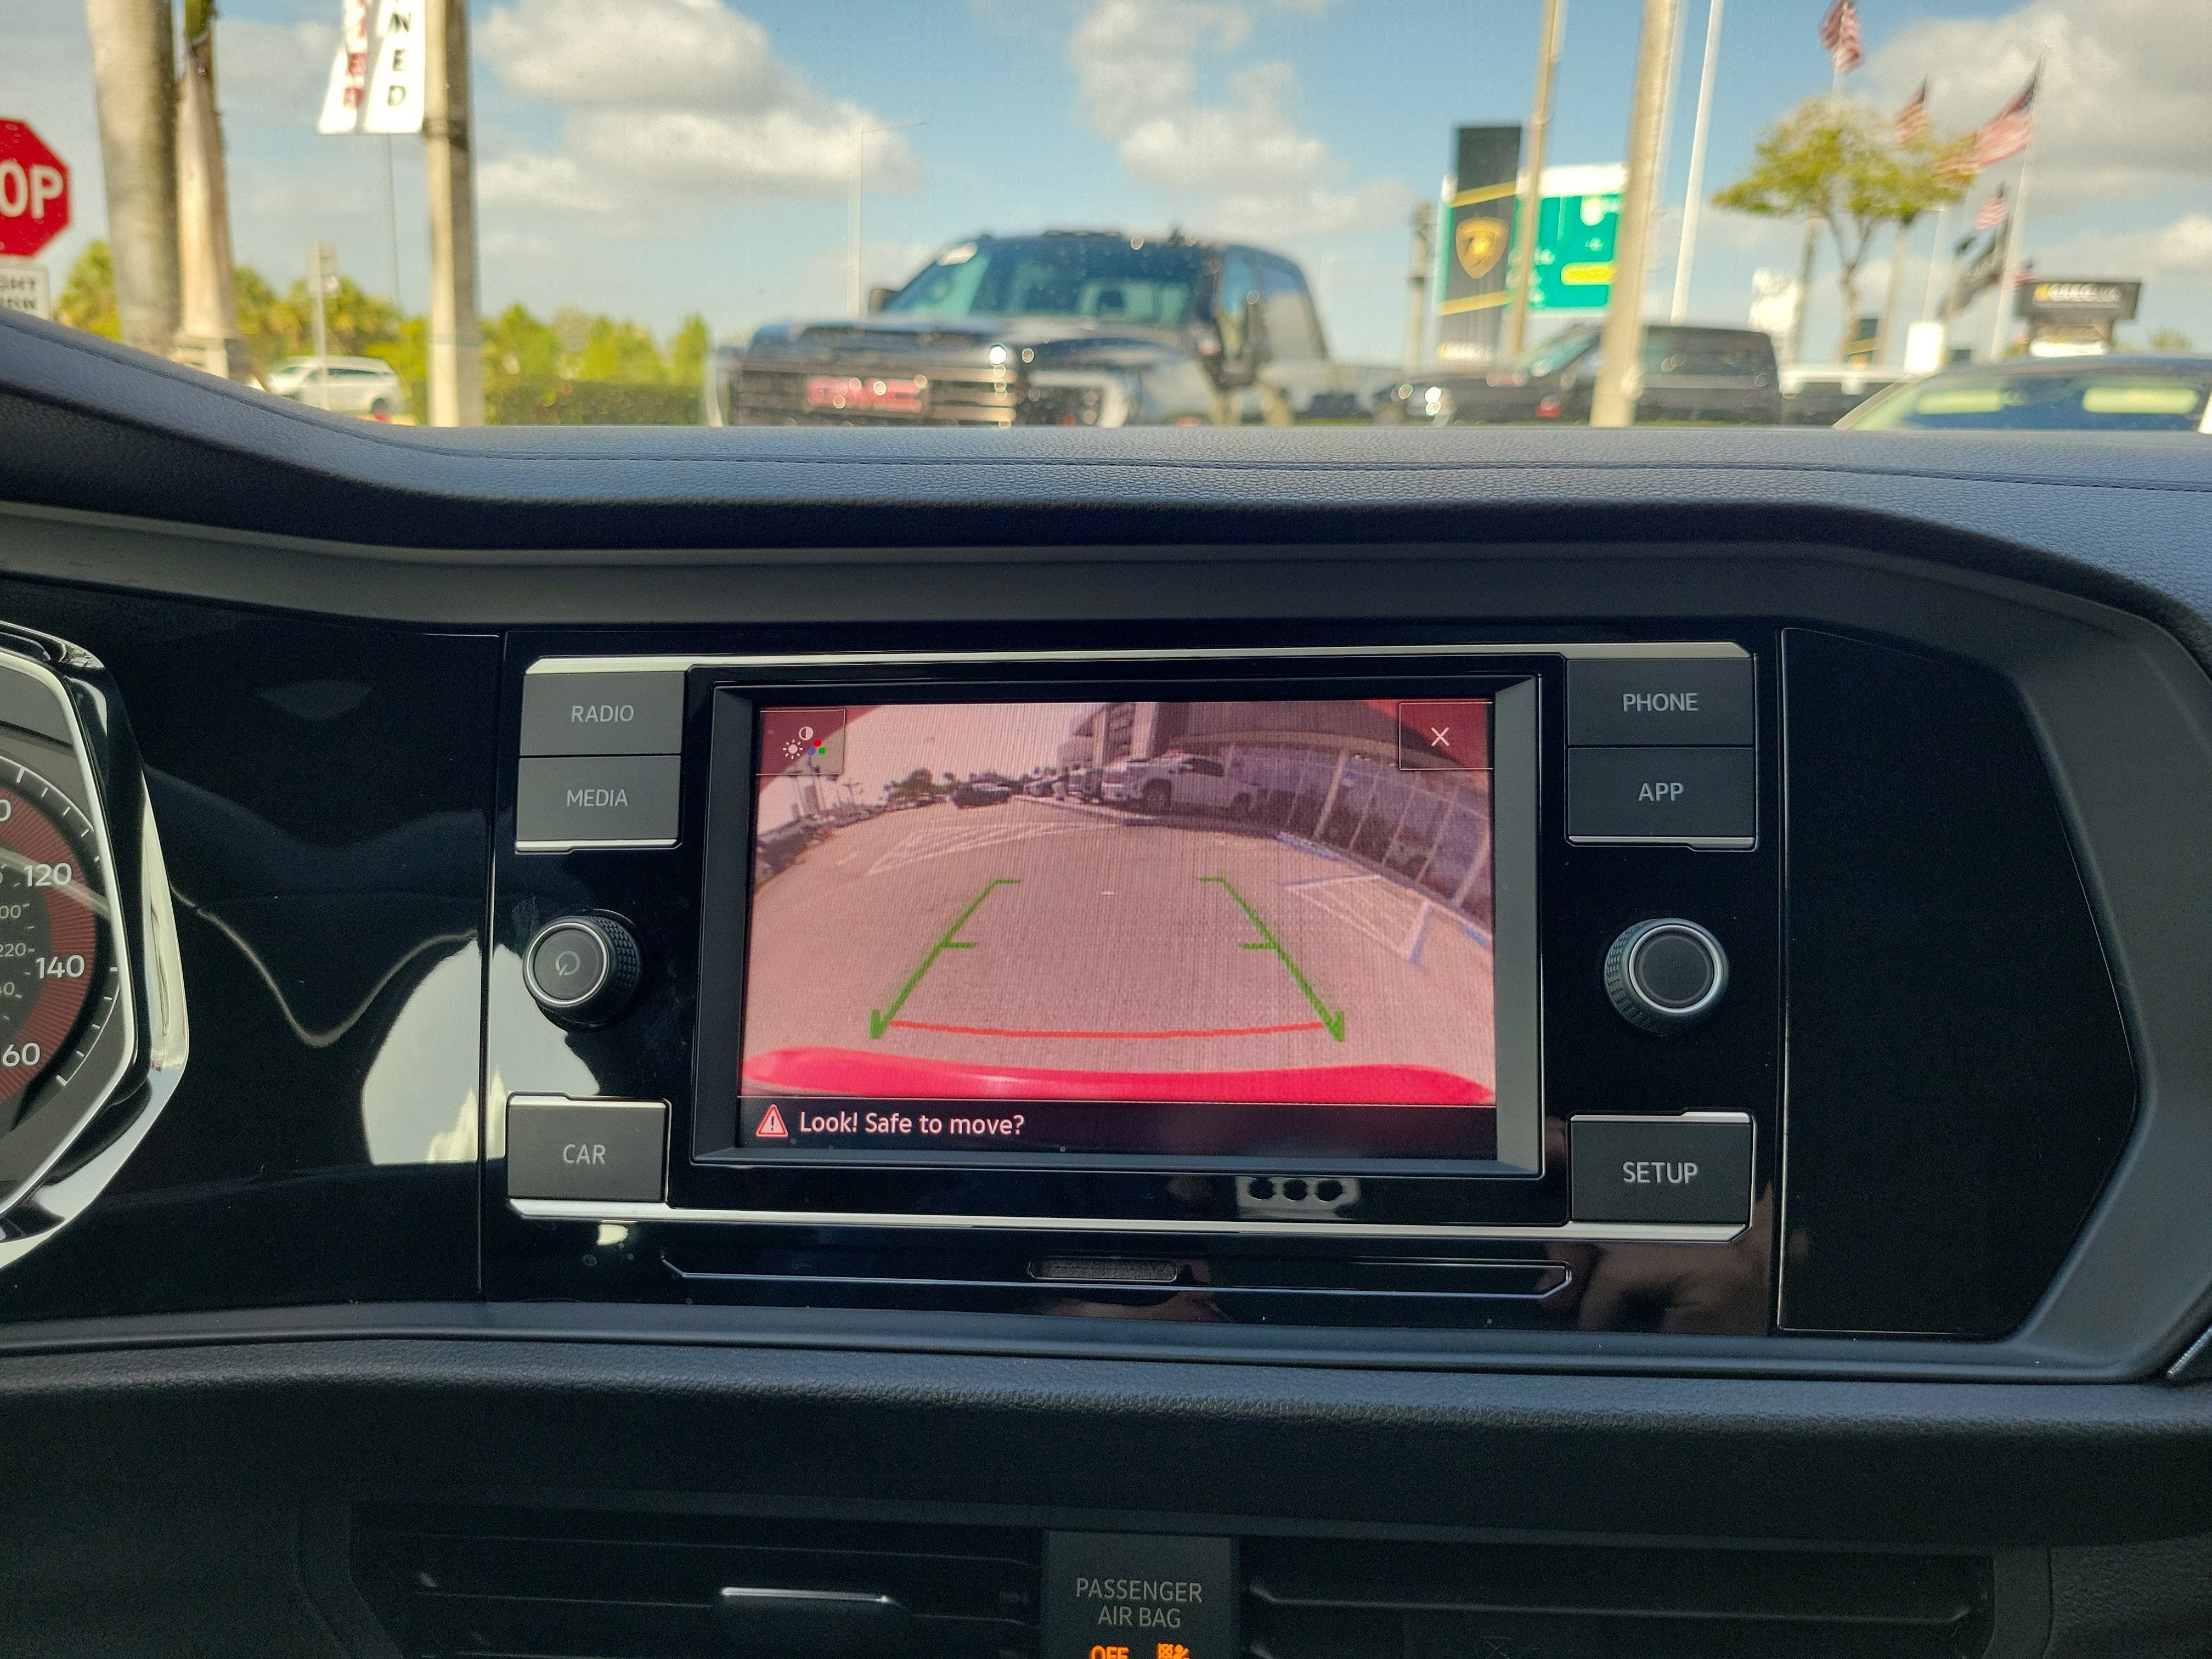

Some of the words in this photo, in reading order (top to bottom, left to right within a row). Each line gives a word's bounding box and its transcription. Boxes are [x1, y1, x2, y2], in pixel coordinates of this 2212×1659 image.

[1623, 693, 1699, 712] PHONE
[571, 705, 634, 723] RADIO
[567, 789, 629, 806] MEDIA
[1638, 782, 1684, 802] APP
[25, 862, 72, 887] 120
[36, 955, 84, 979] 140
[800, 1111, 858, 1133] Look!
[865, 1113, 912, 1133] Safe
[919, 1115, 942, 1134] to
[950, 1115, 1024, 1135] move?
[563, 1144, 606, 1164] CAR
[1623, 1161, 1698, 1183] SETUP
[1076, 1578, 1203, 1602] PASSENGER
[1098, 1605, 1133, 1626] AIR
[1139, 1607, 1181, 1628] BAG
[1090, 1645, 1130, 1659] OFF
